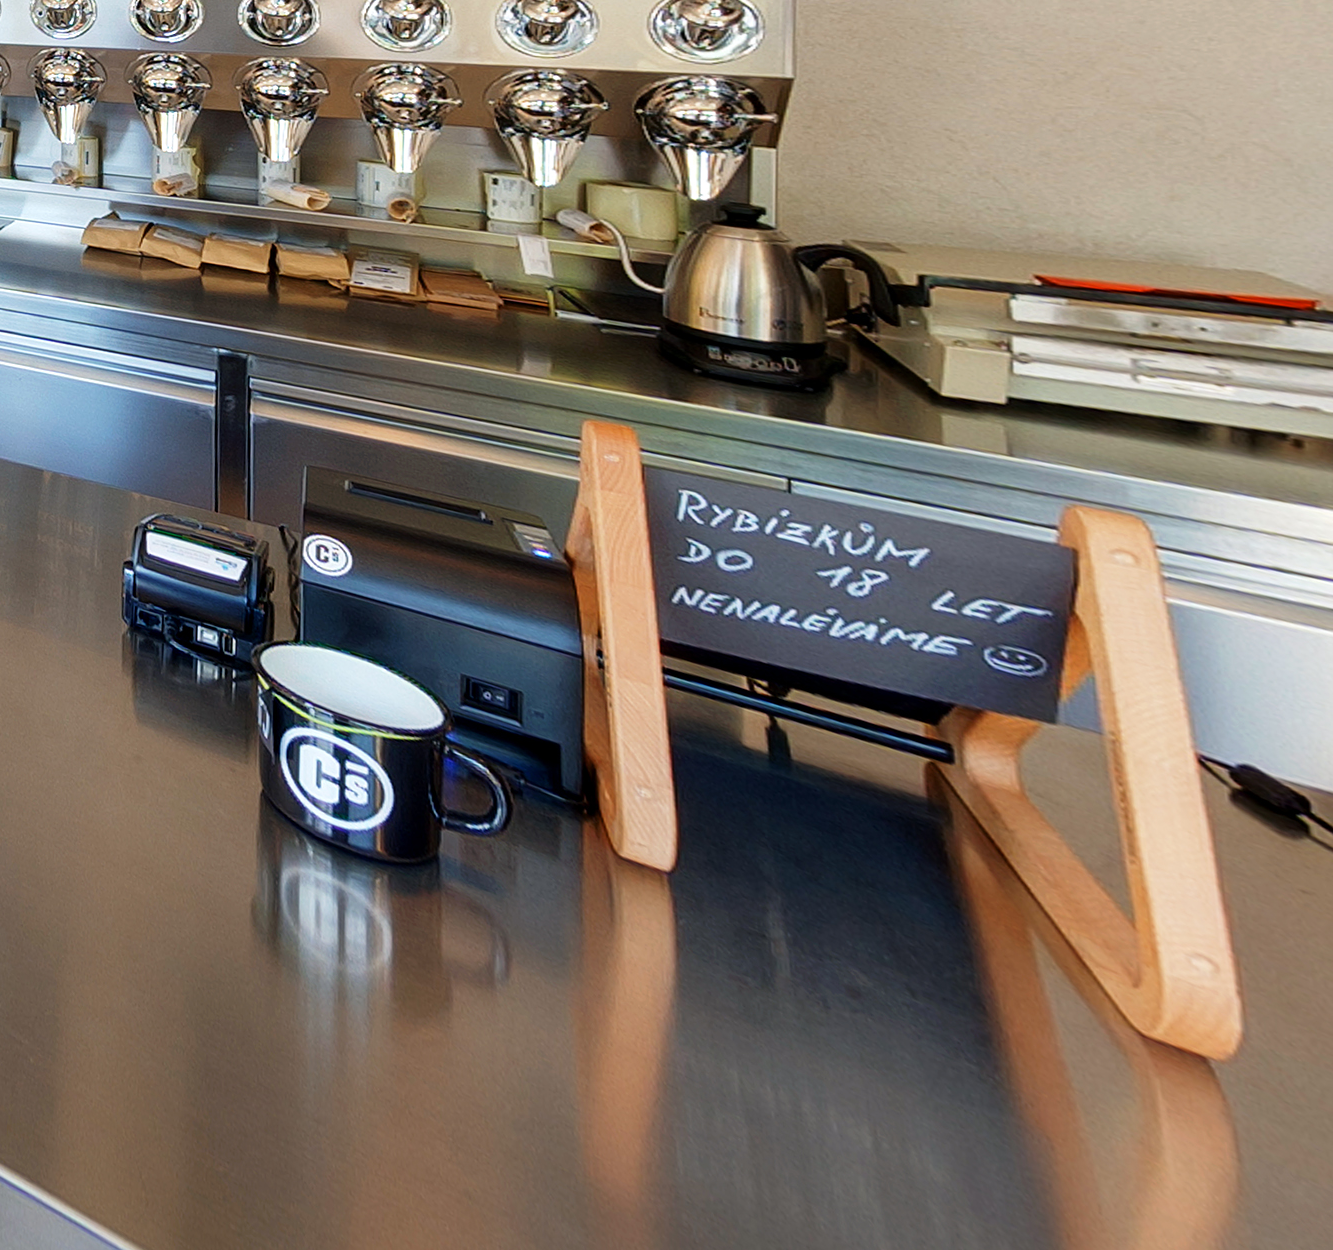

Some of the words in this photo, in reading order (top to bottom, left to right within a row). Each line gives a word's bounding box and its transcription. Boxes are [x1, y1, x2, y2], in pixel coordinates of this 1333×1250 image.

[676, 489, 931, 568] RYBÍZKŮM
[677, 537, 753, 572] DO
[817, 567, 889, 598] 18
[932, 591, 1053, 624] LET
[671, 586, 973, 657] NENALÉVÁME
